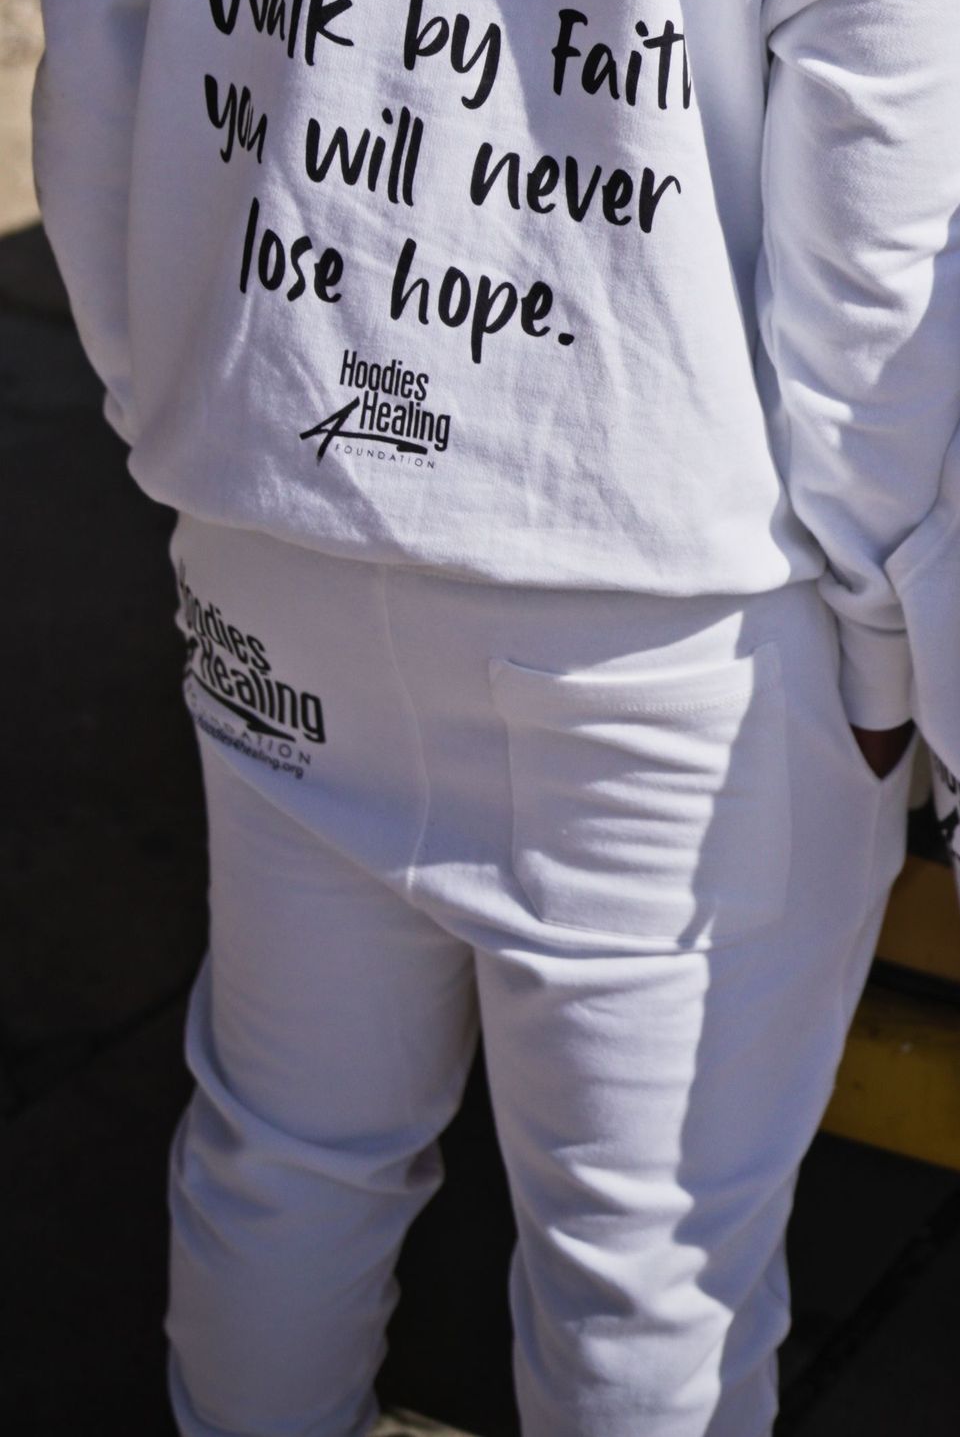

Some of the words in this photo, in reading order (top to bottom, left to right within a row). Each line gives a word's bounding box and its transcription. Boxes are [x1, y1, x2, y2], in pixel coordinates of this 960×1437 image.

[204, 73, 268, 164] you
[305, 105, 424, 207] will
[470, 142, 681, 234] never
[239, 197, 344, 303] lose
[390, 238, 575, 364] hope.
[339, 349, 429, 402] Hoodies
[359, 390, 451, 452] Healing
[334, 443, 436, 469] FOUNDATION
